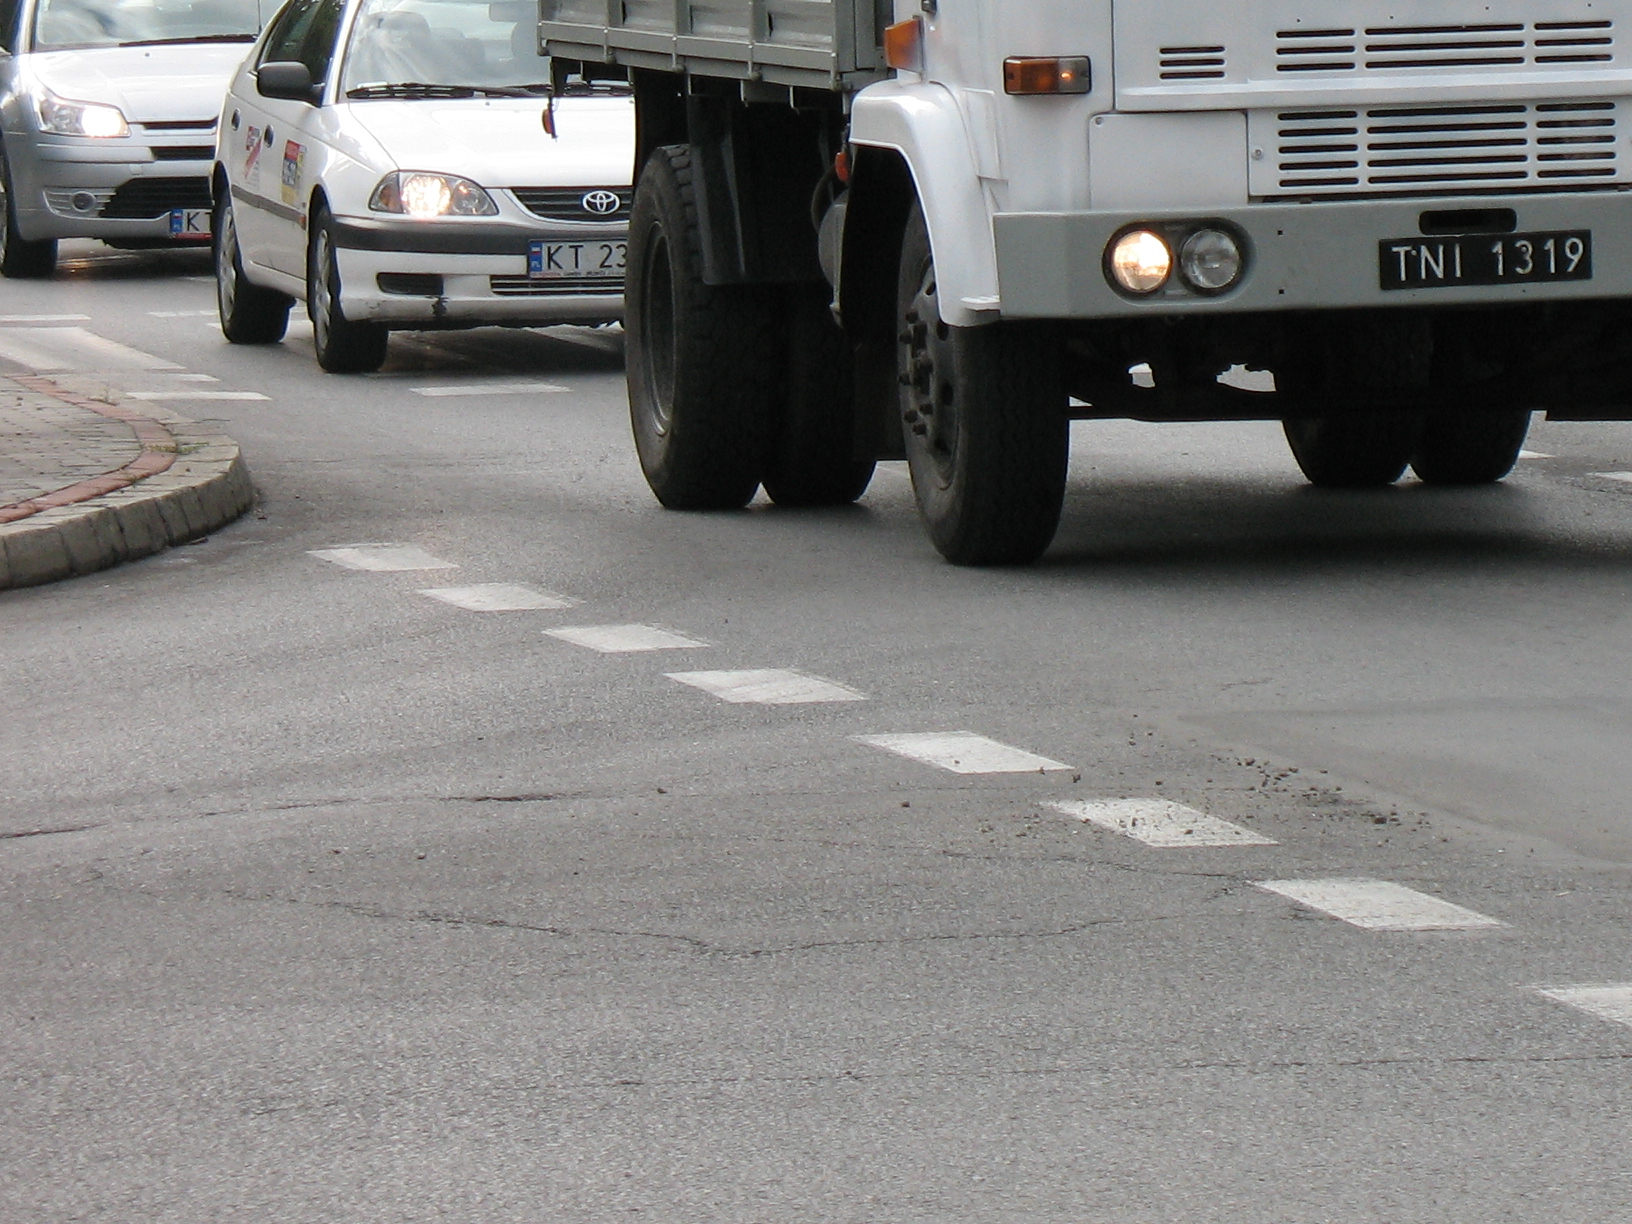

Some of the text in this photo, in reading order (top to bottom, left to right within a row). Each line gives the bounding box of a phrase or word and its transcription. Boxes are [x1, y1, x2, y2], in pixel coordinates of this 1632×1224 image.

[546, 244, 584, 270] KT
[1391, 236, 1585, 282] TNI 1319
